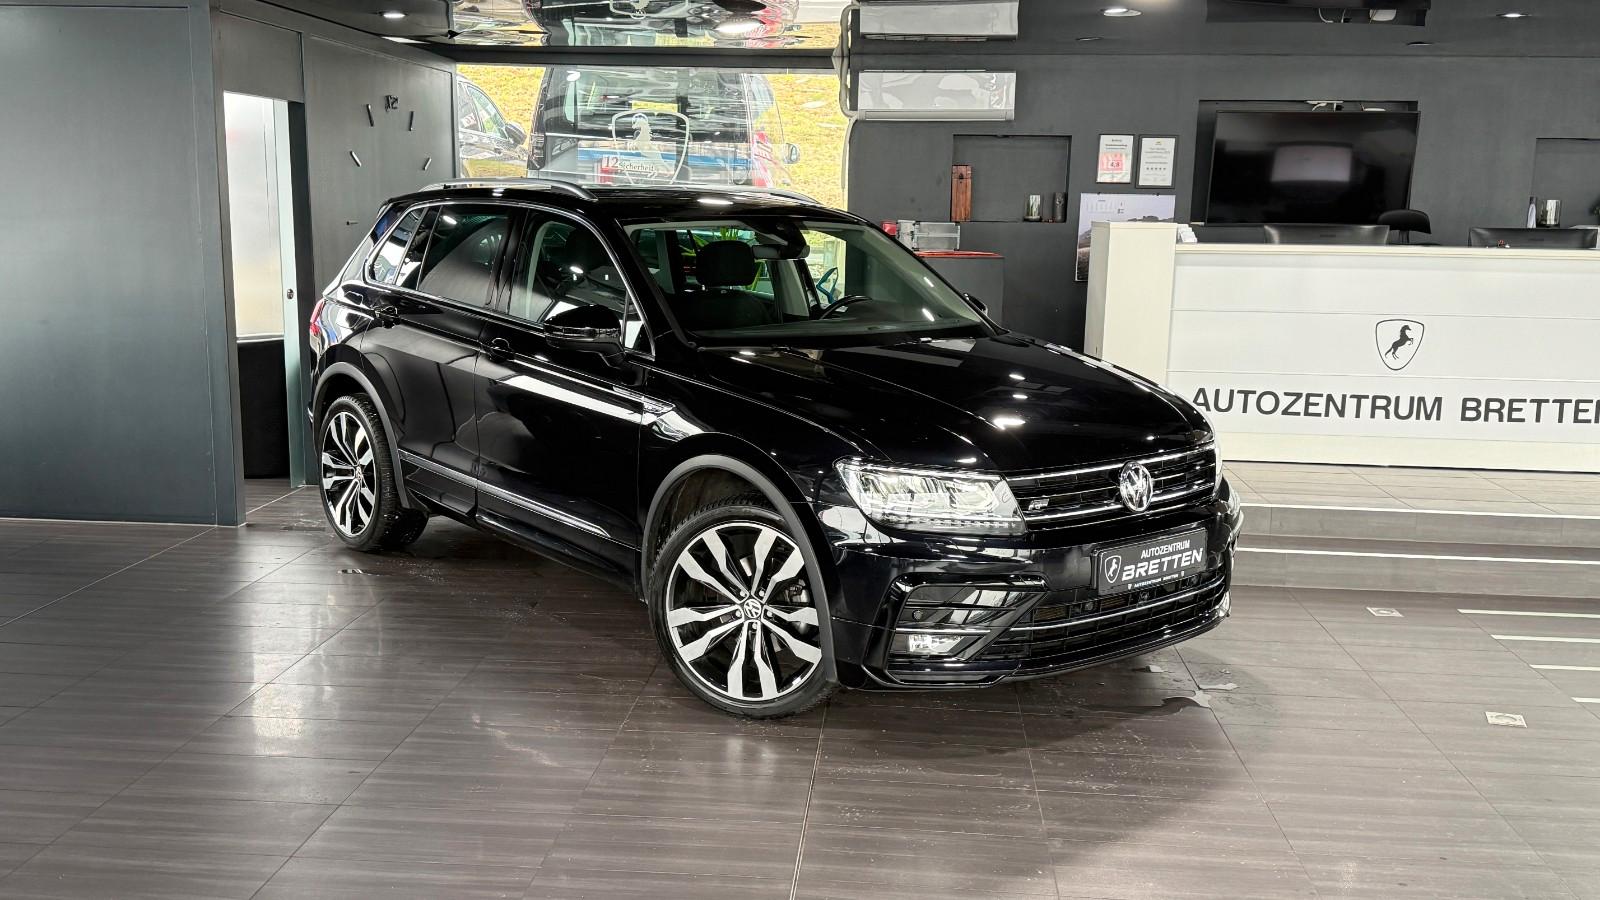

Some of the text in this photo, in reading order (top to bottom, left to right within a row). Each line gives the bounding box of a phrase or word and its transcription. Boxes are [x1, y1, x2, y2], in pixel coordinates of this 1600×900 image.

[1192, 387, 1600, 424] AUTOZENTRUM BRETTE
[1121, 548, 1204, 581] BRETTEN
[1141, 540, 1191, 559] AUTOZENTRUM
